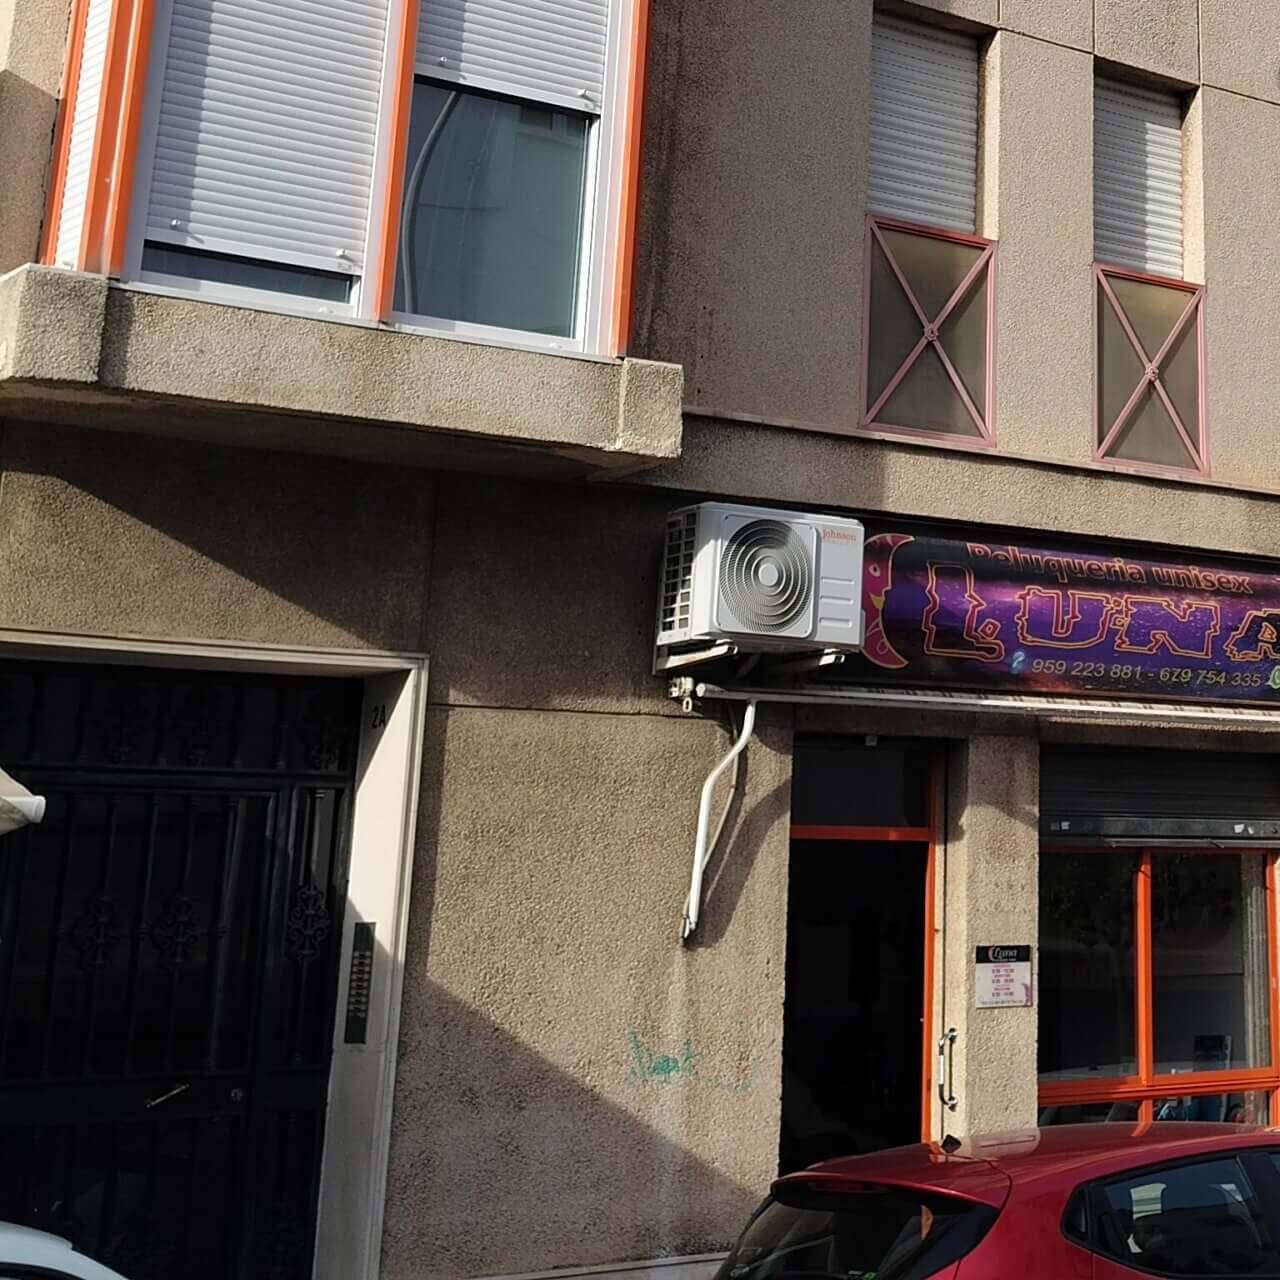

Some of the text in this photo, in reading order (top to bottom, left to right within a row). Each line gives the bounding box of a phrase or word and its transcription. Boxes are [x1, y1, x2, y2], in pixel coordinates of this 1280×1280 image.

[967, 543, 1254, 594] Peluqueria unisex
[1031, 658, 1066, 674] 959
[1071, 661, 1105, 677] 223
[1109, 664, 1143, 680] 881
[1159, 666, 1193, 683] 679
[1196, 669, 1227, 685] 754
[1231, 671, 1262, 687] 335
